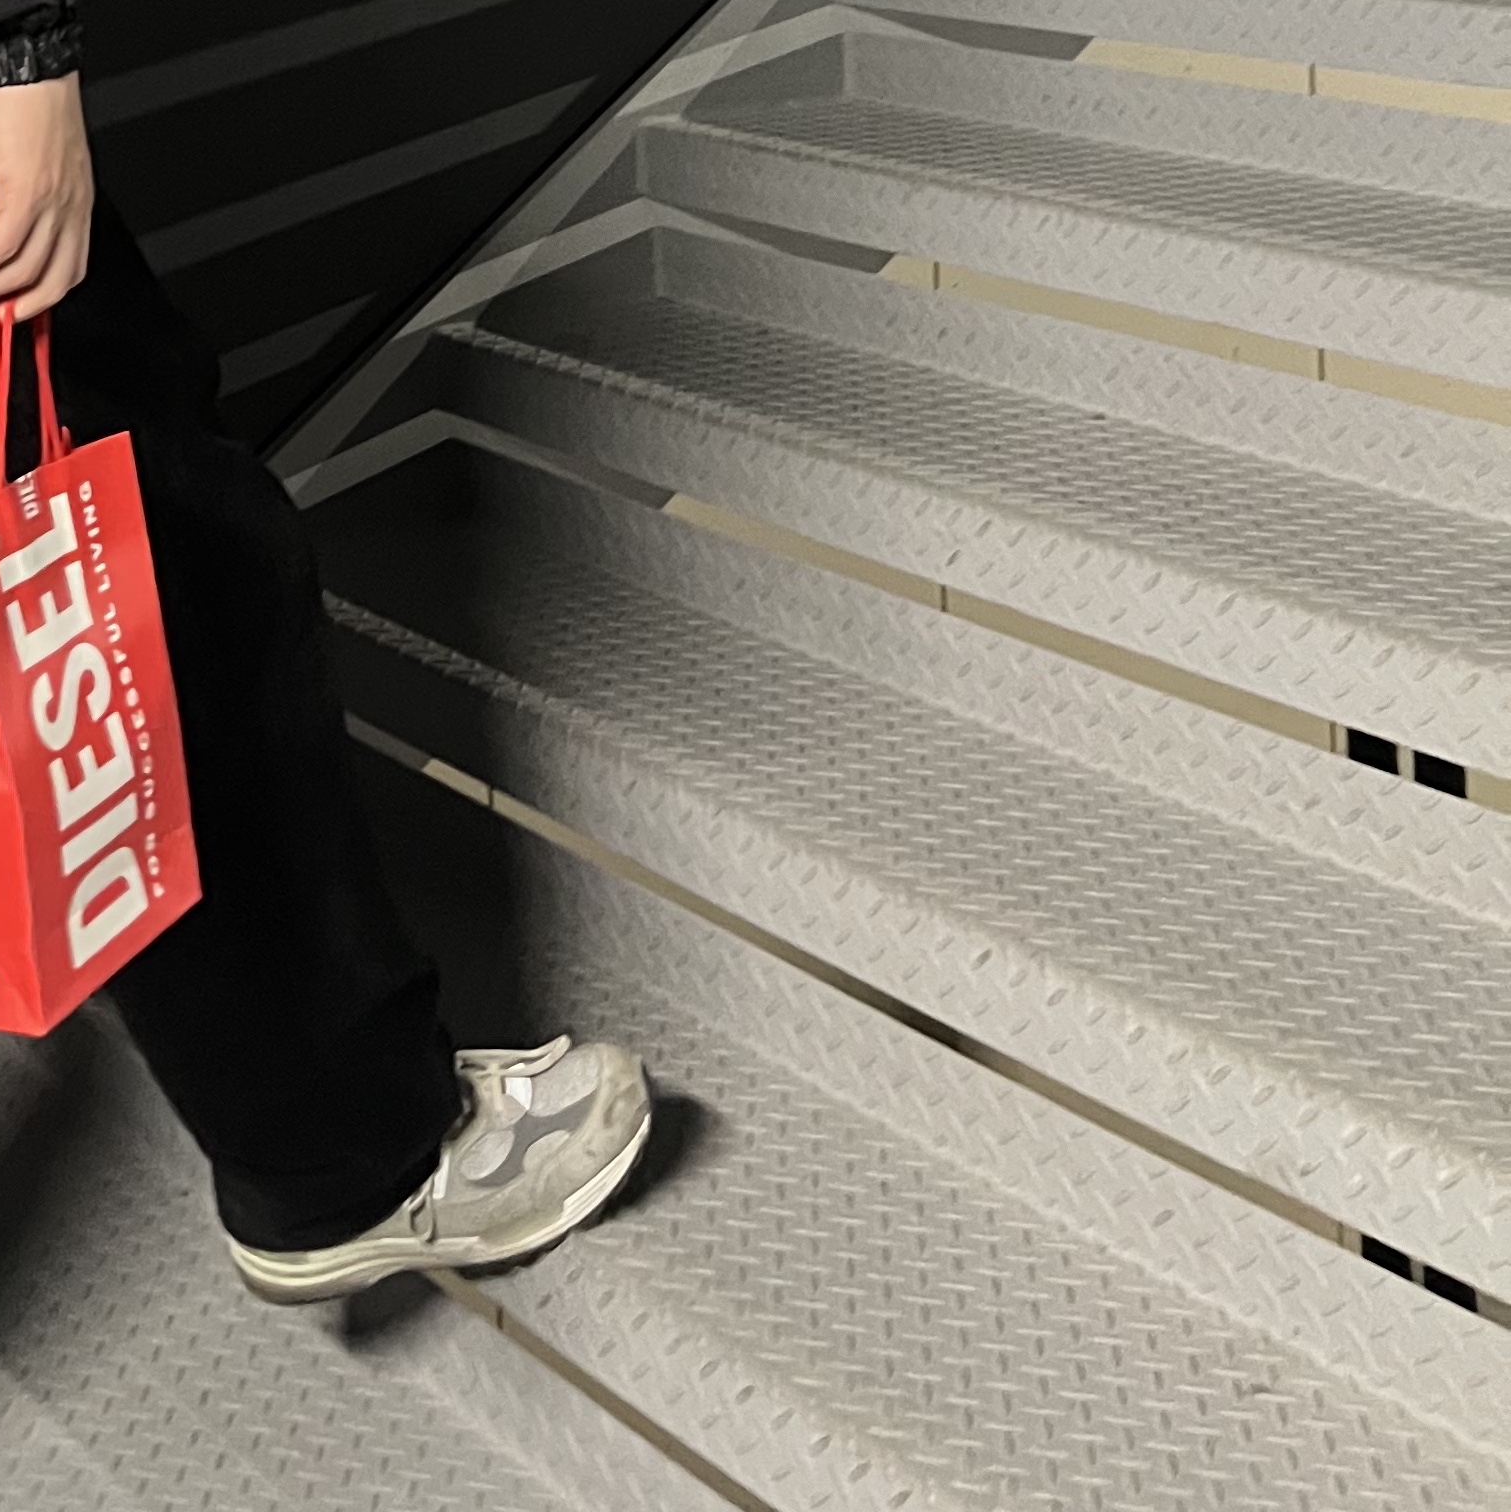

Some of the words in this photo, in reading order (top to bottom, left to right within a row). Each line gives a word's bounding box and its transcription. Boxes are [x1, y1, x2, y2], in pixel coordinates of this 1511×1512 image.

[78, 480, 112, 594] LIVING
[104, 603, 157, 821] SUCCESSFUL
[144, 832, 166, 898] FOR
